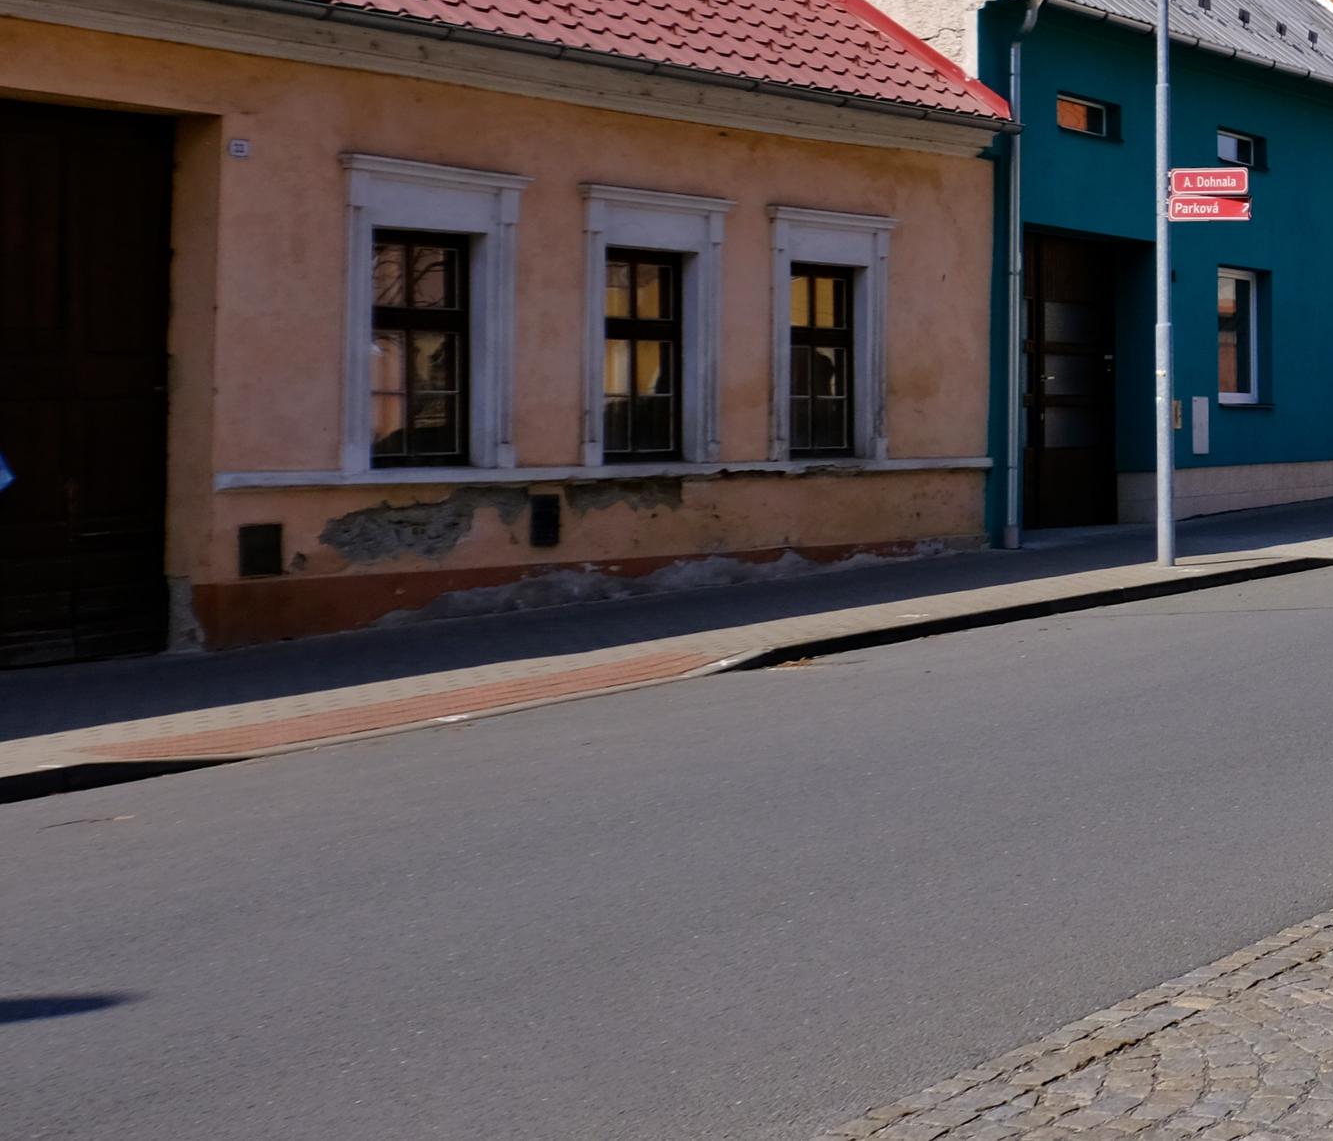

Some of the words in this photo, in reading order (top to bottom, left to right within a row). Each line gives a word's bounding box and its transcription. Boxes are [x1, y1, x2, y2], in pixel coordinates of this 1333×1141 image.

[1183, 176, 1193, 188] A.
[1197, 176, 1236, 188] Dohnala
[1175, 201, 1219, 214] Parková
